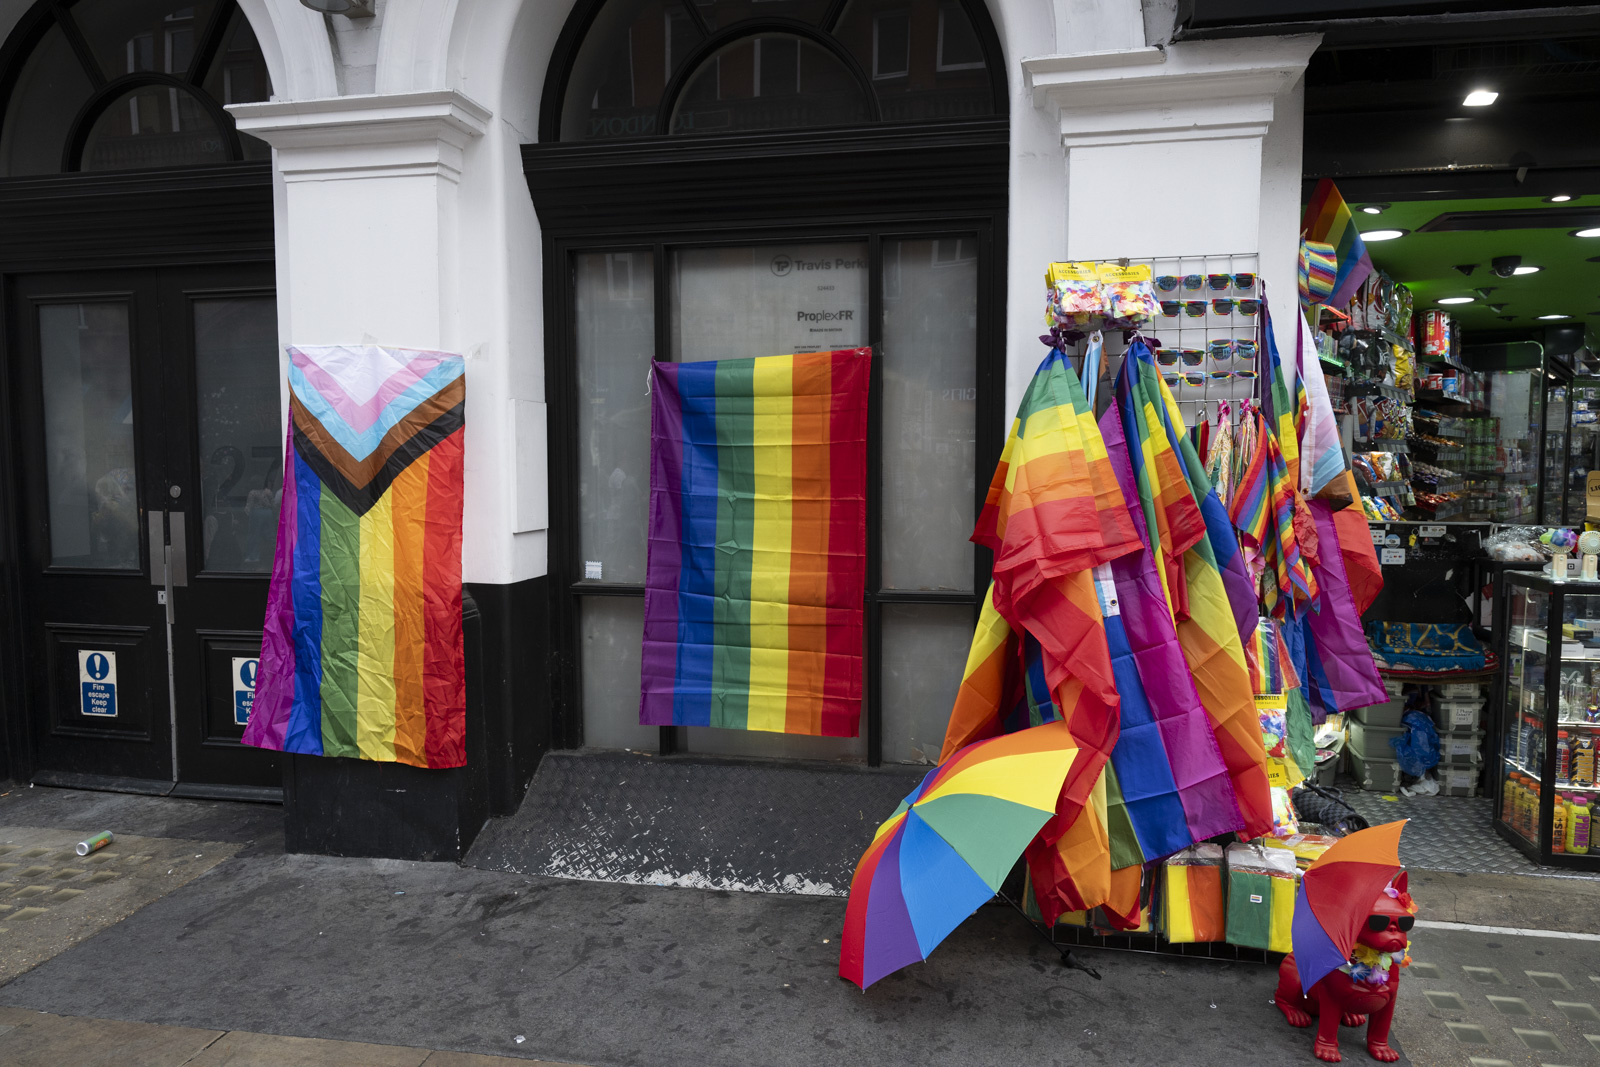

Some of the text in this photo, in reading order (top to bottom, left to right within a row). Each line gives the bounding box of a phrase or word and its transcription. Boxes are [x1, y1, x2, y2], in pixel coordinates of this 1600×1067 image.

[795, 259, 832, 271] Travis
[797, 310, 853, 323] ProplexFR
[92, 683, 105, 691] Fire
[88, 691, 110, 699] escape
[91, 698, 107, 707] Keep
[1577, 748, 1594, 782] PRIME
[1573, 815, 1590, 848] PRIME
